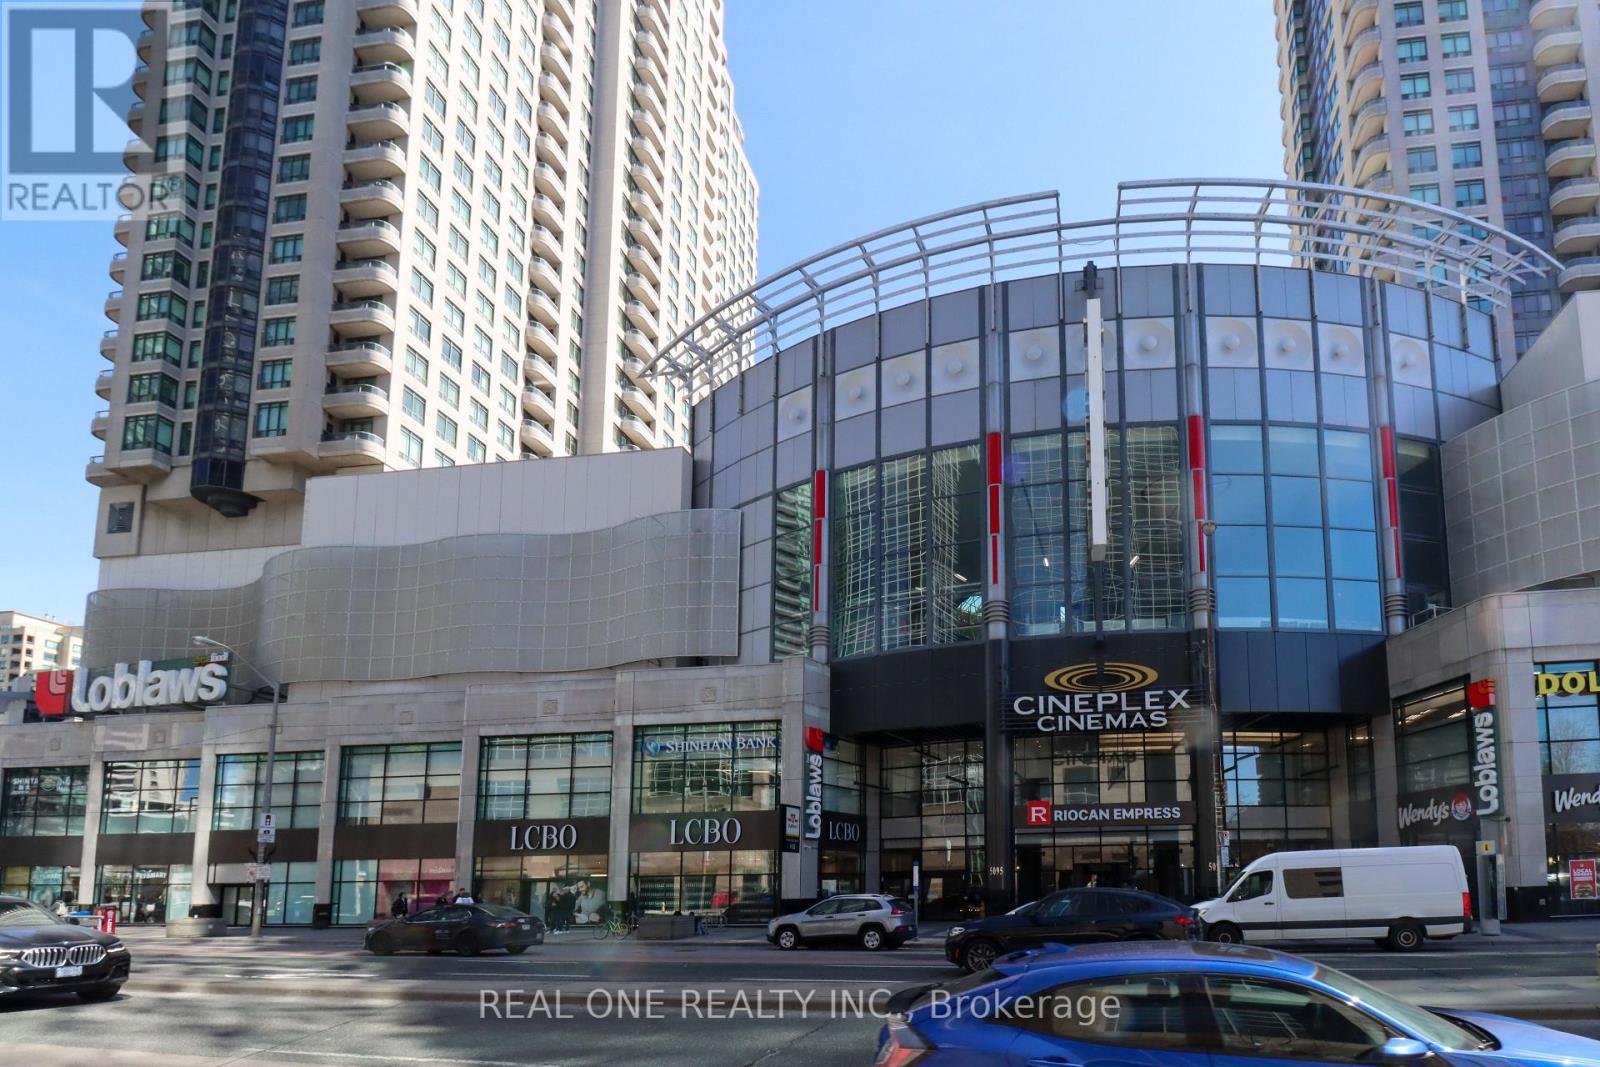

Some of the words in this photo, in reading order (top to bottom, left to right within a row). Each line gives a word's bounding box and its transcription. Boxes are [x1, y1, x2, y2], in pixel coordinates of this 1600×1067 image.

[71, 660, 228, 713] Loblaws
[1013, 689, 1191, 715] CINEPLEX
[1037, 711, 1168, 732] CINEMAS
[665, 739, 732, 753] SHINHAN
[735, 736, 777, 750] BANK
[1473, 711, 1499, 816] Loblaws
[805, 754, 822, 839] Loblaws
[1054, 809, 1110, 822] RIOCAN
[1113, 806, 1181, 820] EMPRESS
[1398, 798, 1450, 830] Wendy's
[510, 824, 577, 850] LCBO
[670, 817, 742, 845] LCBO
[829, 820, 860, 841] LCBO
